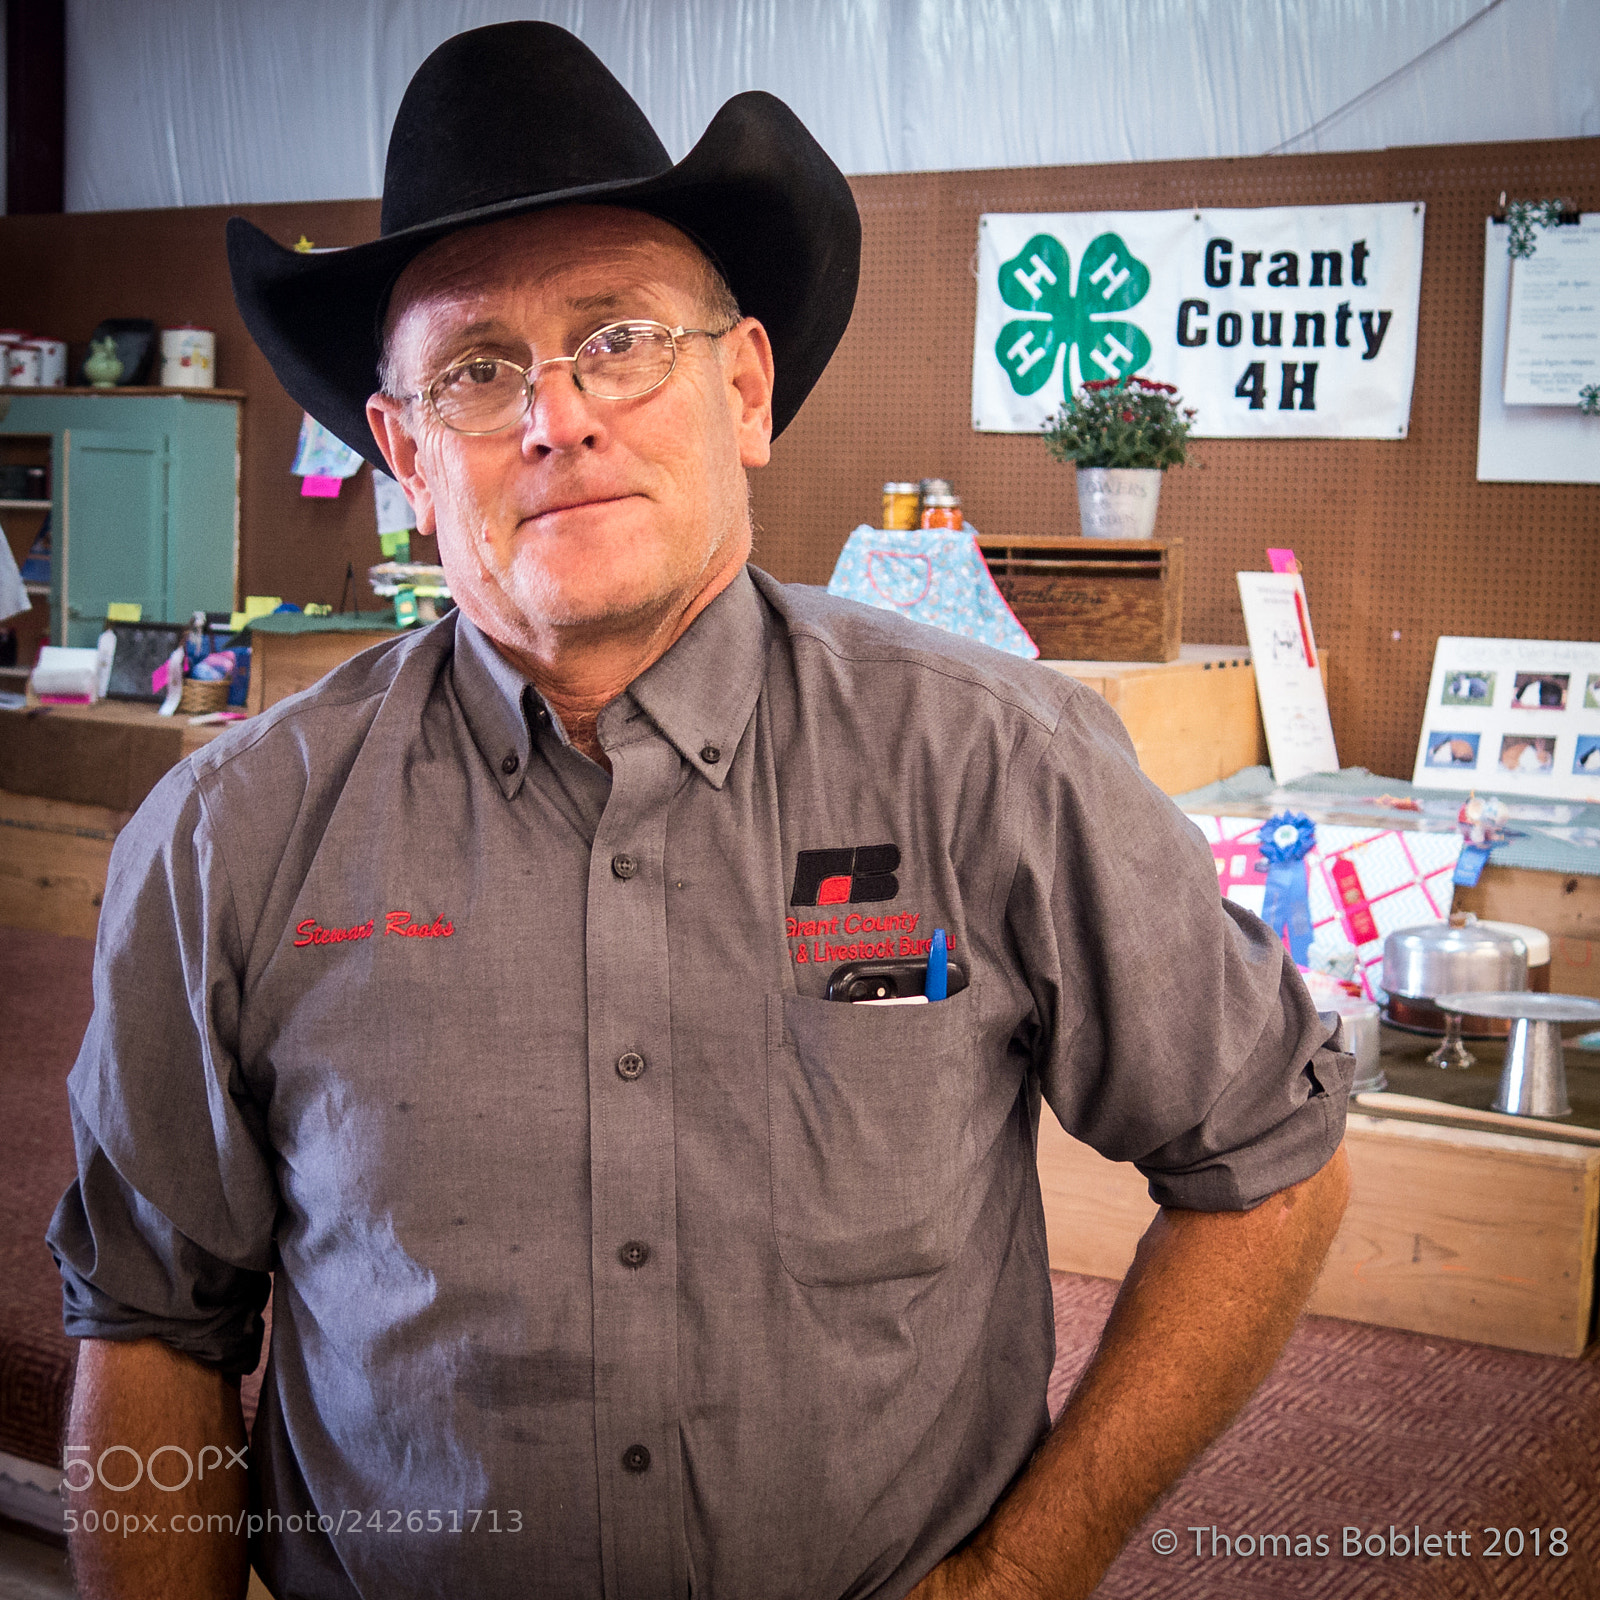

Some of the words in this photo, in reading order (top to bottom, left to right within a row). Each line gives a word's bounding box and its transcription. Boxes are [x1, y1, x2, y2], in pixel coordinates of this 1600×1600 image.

[1013, 253, 1057, 299] H
[1089, 252, 1131, 299] H
[1204, 236, 1370, 288] Grant
[1176, 298, 1393, 360] County
[1006, 330, 1046, 377] H
[1089, 332, 1134, 379] H
[1235, 360, 1320, 410] 4H
[293, 918, 375, 948] Stewart
[844, 911, 920, 934] County
[796, 943, 809, 963] &
[814, 937, 896, 962] Livestock
[899, 934, 956, 956] Buru
